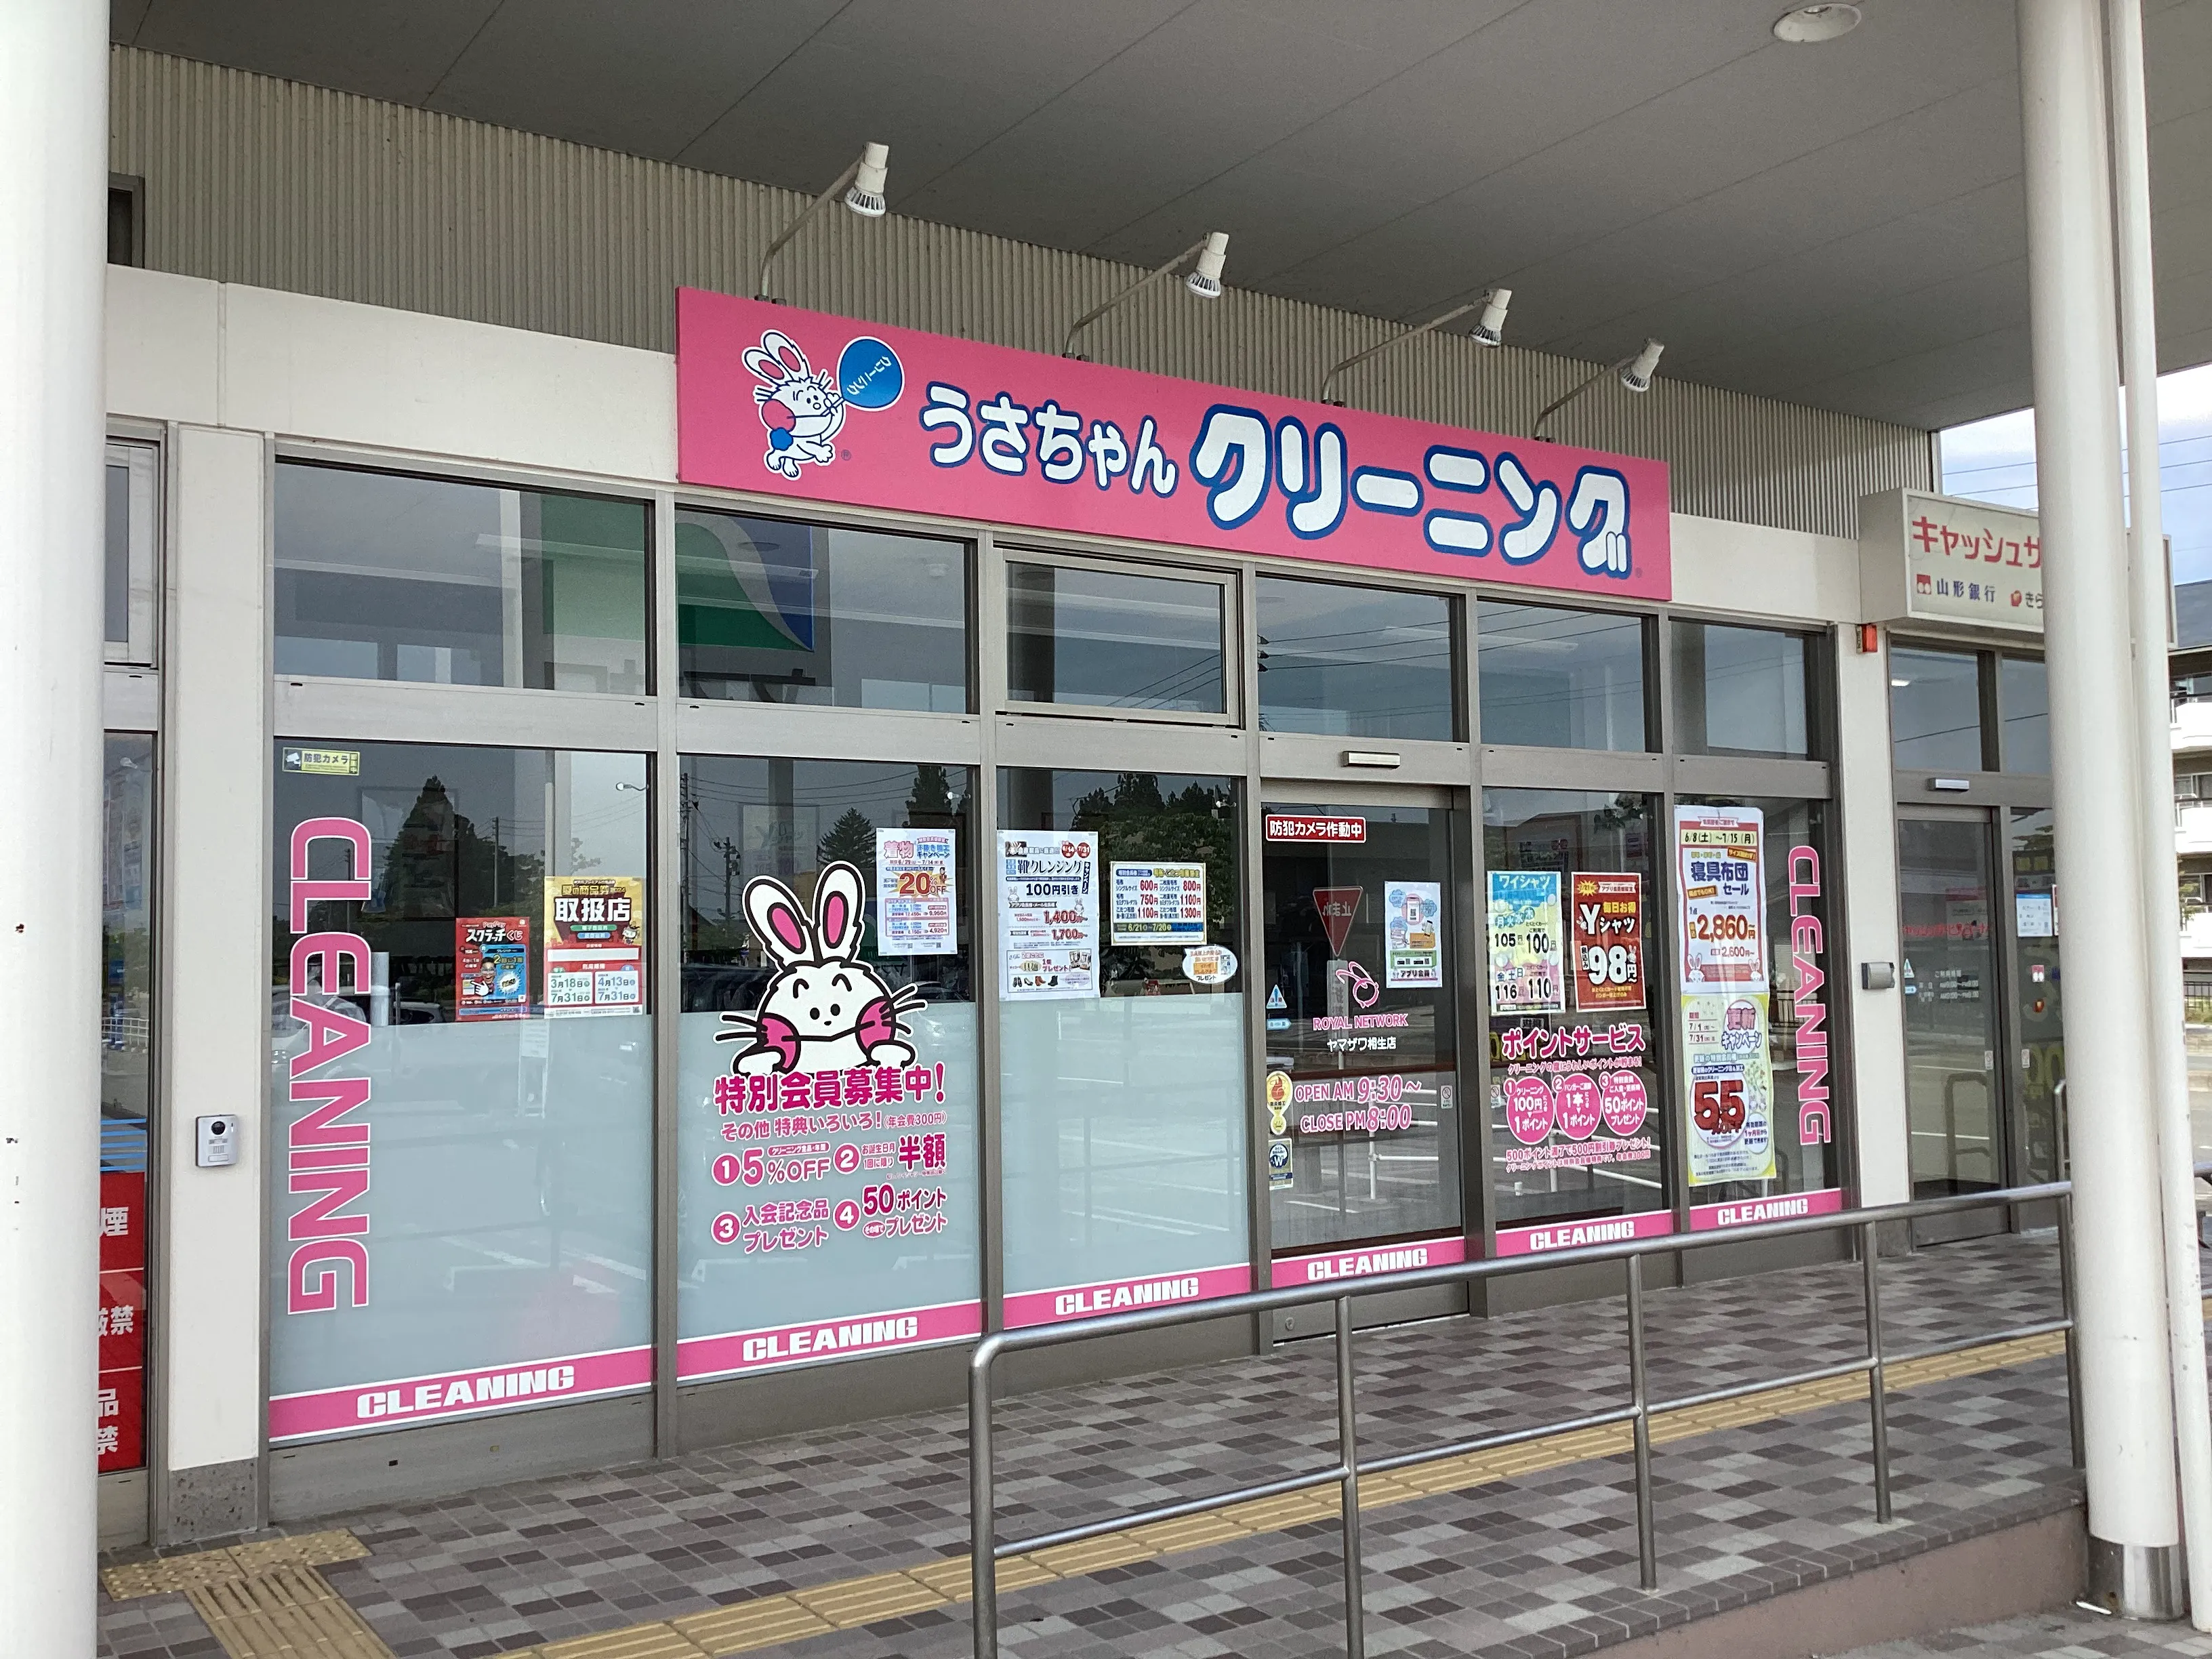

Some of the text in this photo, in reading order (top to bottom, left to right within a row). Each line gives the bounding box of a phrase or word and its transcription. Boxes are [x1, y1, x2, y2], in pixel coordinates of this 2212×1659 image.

[920, 381, 1631, 579] うさちゃん クリーニング
[1912, 516, 2041, 568] キャッシュサ
[1937, 578, 1996, 603] 山形銀行
[304, 753, 348, 764] 防犯カメラ
[1269, 820, 1362, 838] 防犯カメラ作動中
[884, 840, 914, 859] 着物
[1018, 859, 1083, 874] 靴クレンジング
[1691, 861, 1748, 882] 寝具布団
[899, 872, 930, 895] 20
[1026, 884, 1078, 896] 100円引き
[1140, 880, 1158, 891] 600円
[1183, 880, 1201, 891] 800円
[1499, 875, 1551, 889] ワイシャツ
[1723, 882, 1749, 895] セール
[554, 897, 631, 922] 取扱店
[1140, 894, 1158, 905] 750円
[1603, 901, 1636, 914] 毎日お得
[483, 920, 506, 929] PayPay
[1580, 903, 1635, 935] Yシャツ
[466, 928, 523, 943] スクラッチくじ
[550, 977, 629, 989] 3月18日 4月13日
[550, 991, 629, 1003] 7月31日 7月31日
[1788, 846, 1831, 1145] CLEANING
[1313, 1013, 1409, 1031] ROYAL NETWORK
[1327, 1036, 1397, 1051] ヤマザワ相生店
[1502, 1022, 1646, 1060] ポイントサービス
[1721, 1031, 1762, 1050] キャンペーン
[287, 817, 372, 1315] CLEANING
[713, 1062, 946, 1116] 特別会員募集中!
[1294, 1084, 1331, 1103] OPEN
[1332, 1080, 1355, 1101] AM
[1516, 1086, 1544, 1096] クリーニング
[1513, 1096, 1542, 1112] 100円
[1565, 1092, 1584, 1108] 1本
[1604, 1096, 1644, 1114] 50ポイント
[720, 1123, 771, 1142] その他
[775, 1111, 882, 1136] 特典いろいろ!
[1300, 1104, 1412, 1134] CLOSE PM 8:00
[1514, 1115, 1549, 1134] 1ポイント
[1562, 1112, 1596, 1130] 1ポイント
[1611, 1113, 1640, 1126] プレゼント
[861, 1143, 896, 1155] お誕生日月
[899, 1134, 947, 1171] 半額
[767, 1159, 831, 1185] %OFF
[863, 1182, 947, 1216] 50ポイント
[742, 1200, 828, 1225] 入会記念品
[1717, 1198, 1808, 1225] CLEANING
[885, 1213, 948, 1238] プレゼント
[1530, 1221, 1635, 1251] CLEANING
[743, 1225, 828, 1254] プレゼント
[1307, 1248, 1428, 1282] CLEANING
[1054, 1277, 1200, 1317] CLEANING
[743, 1316, 919, 1362] CLEANING
[356, 1365, 575, 1420] CLEANING
